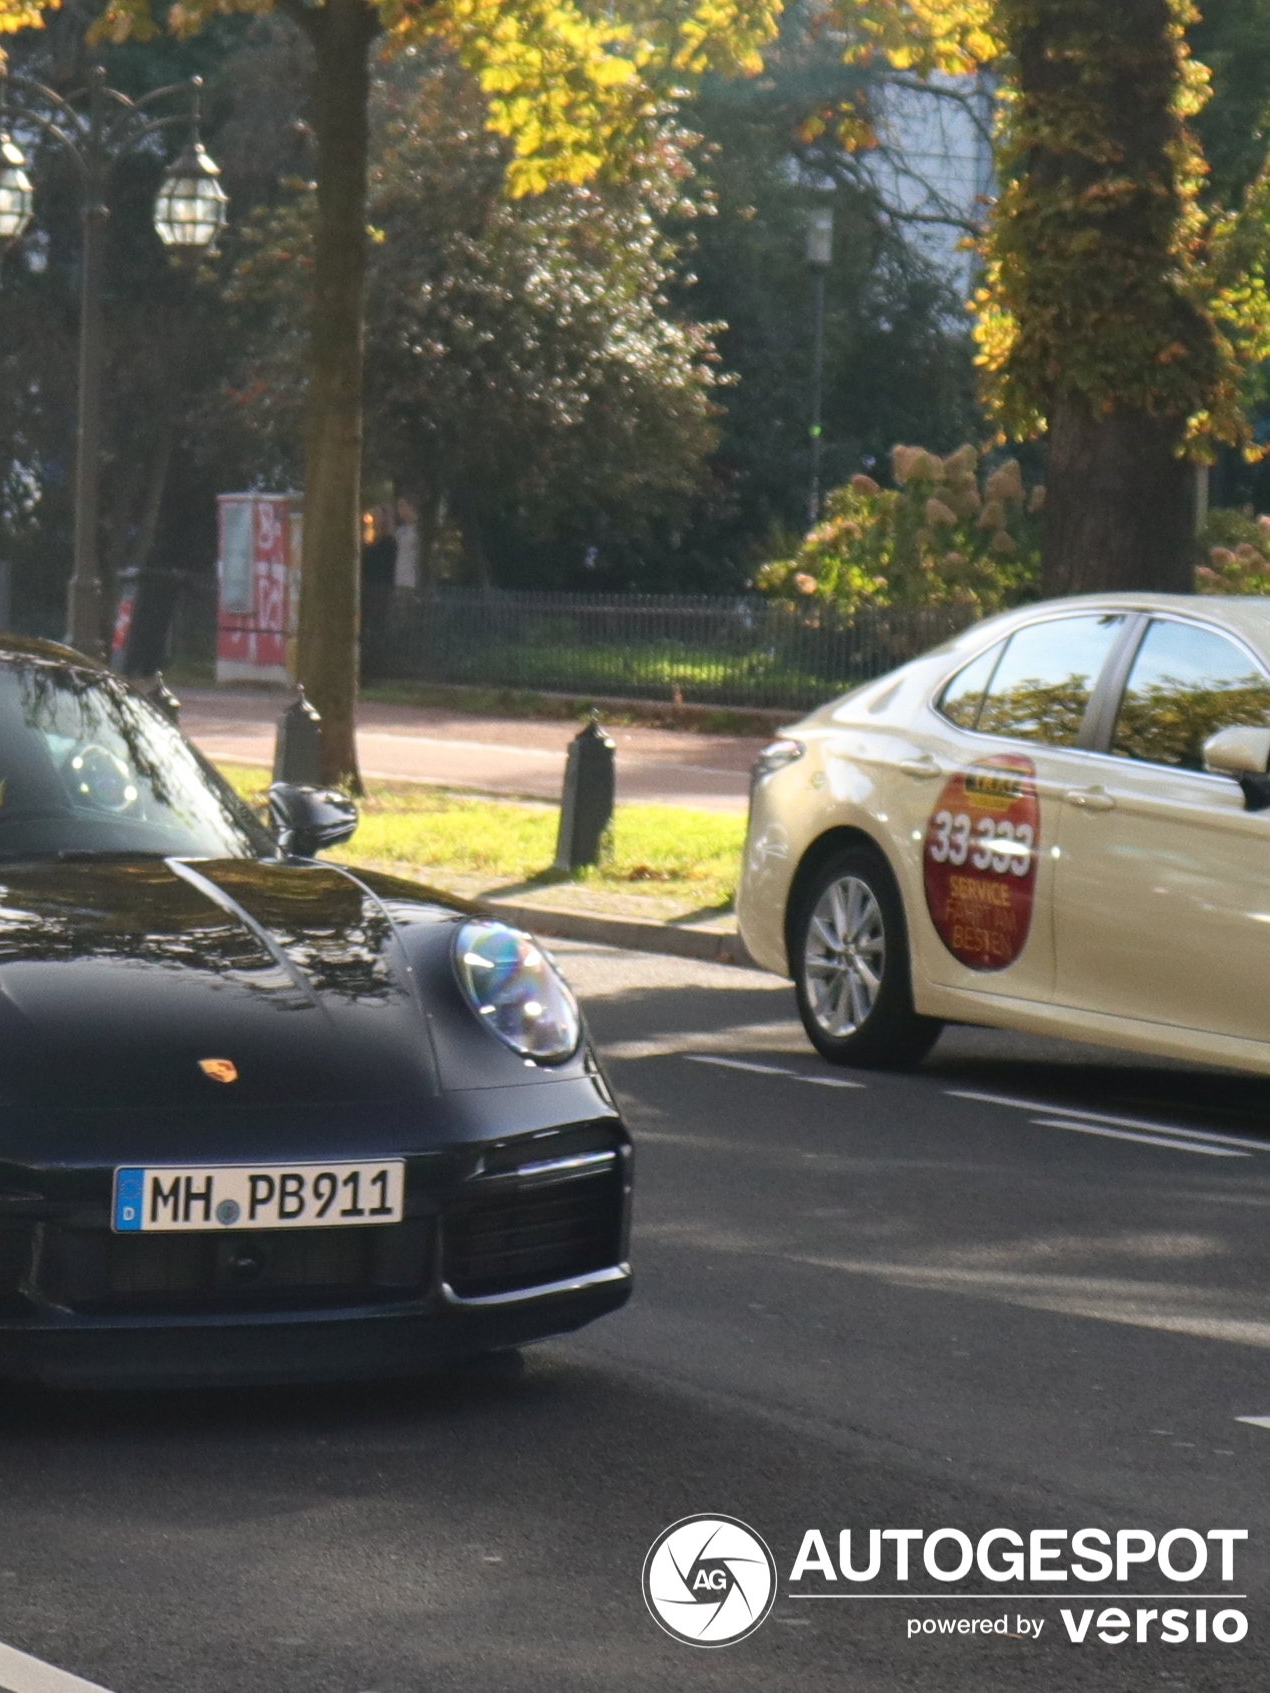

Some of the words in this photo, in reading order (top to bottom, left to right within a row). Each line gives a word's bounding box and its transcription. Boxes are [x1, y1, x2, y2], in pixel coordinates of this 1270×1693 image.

[930, 810, 971, 867] 33
[950, 874, 1012, 907] SERVICE
[122, 1208, 135, 1220] D
[150, 1175, 214, 1222] MH
